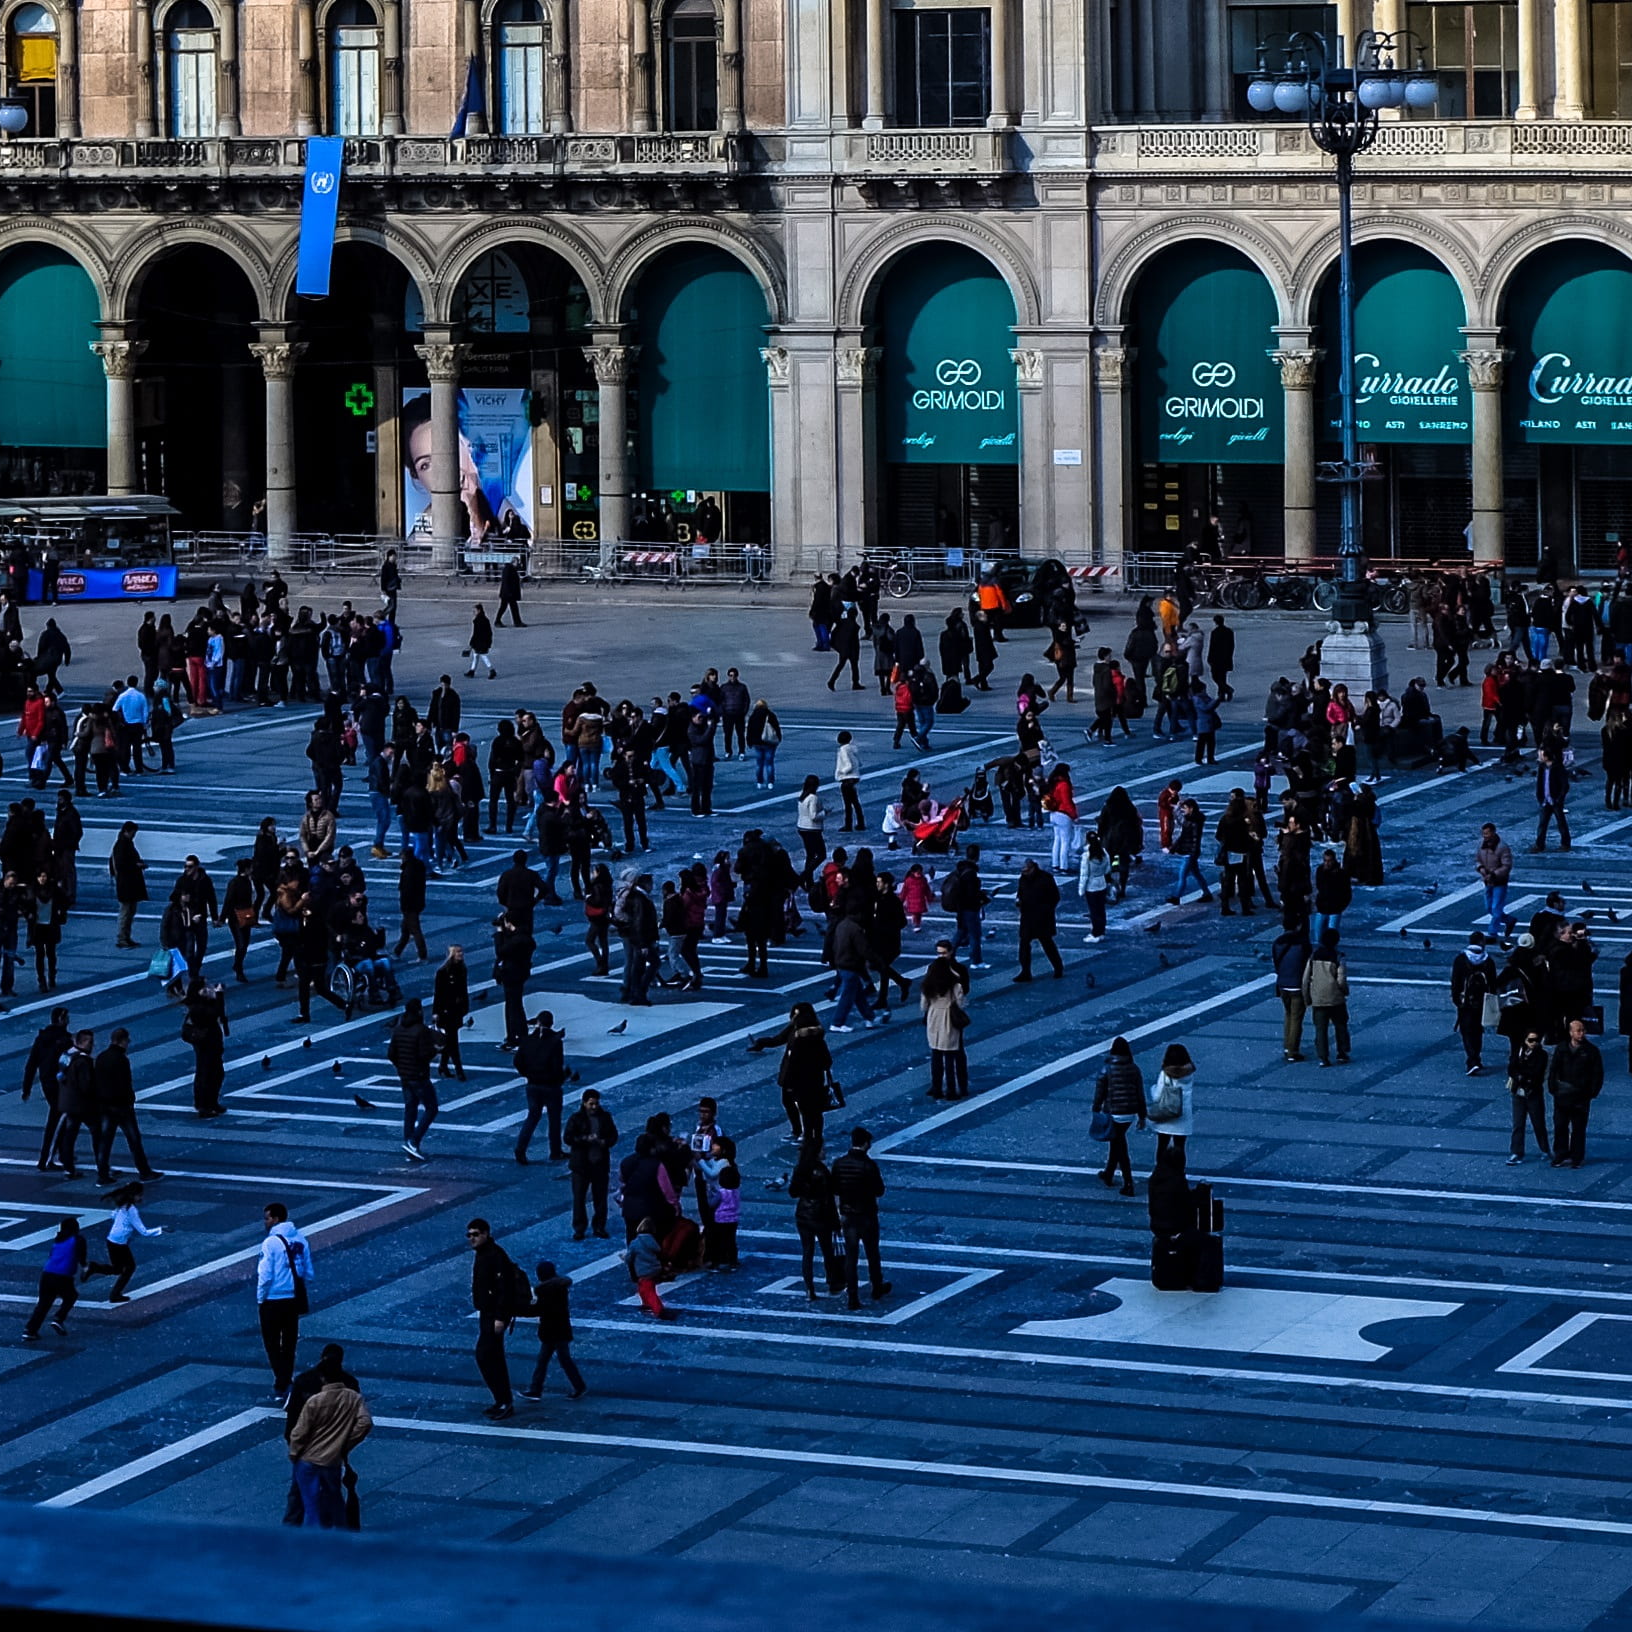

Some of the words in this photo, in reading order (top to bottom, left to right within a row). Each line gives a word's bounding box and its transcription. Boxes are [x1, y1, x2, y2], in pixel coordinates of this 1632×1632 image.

[474, 395, 508, 405] VICHY
[912, 390, 1005, 410] GRIMOLDI
[1165, 397, 1264, 418] GRIMOLDI
[1389, 395, 1459, 405] GIOIELLERIE
